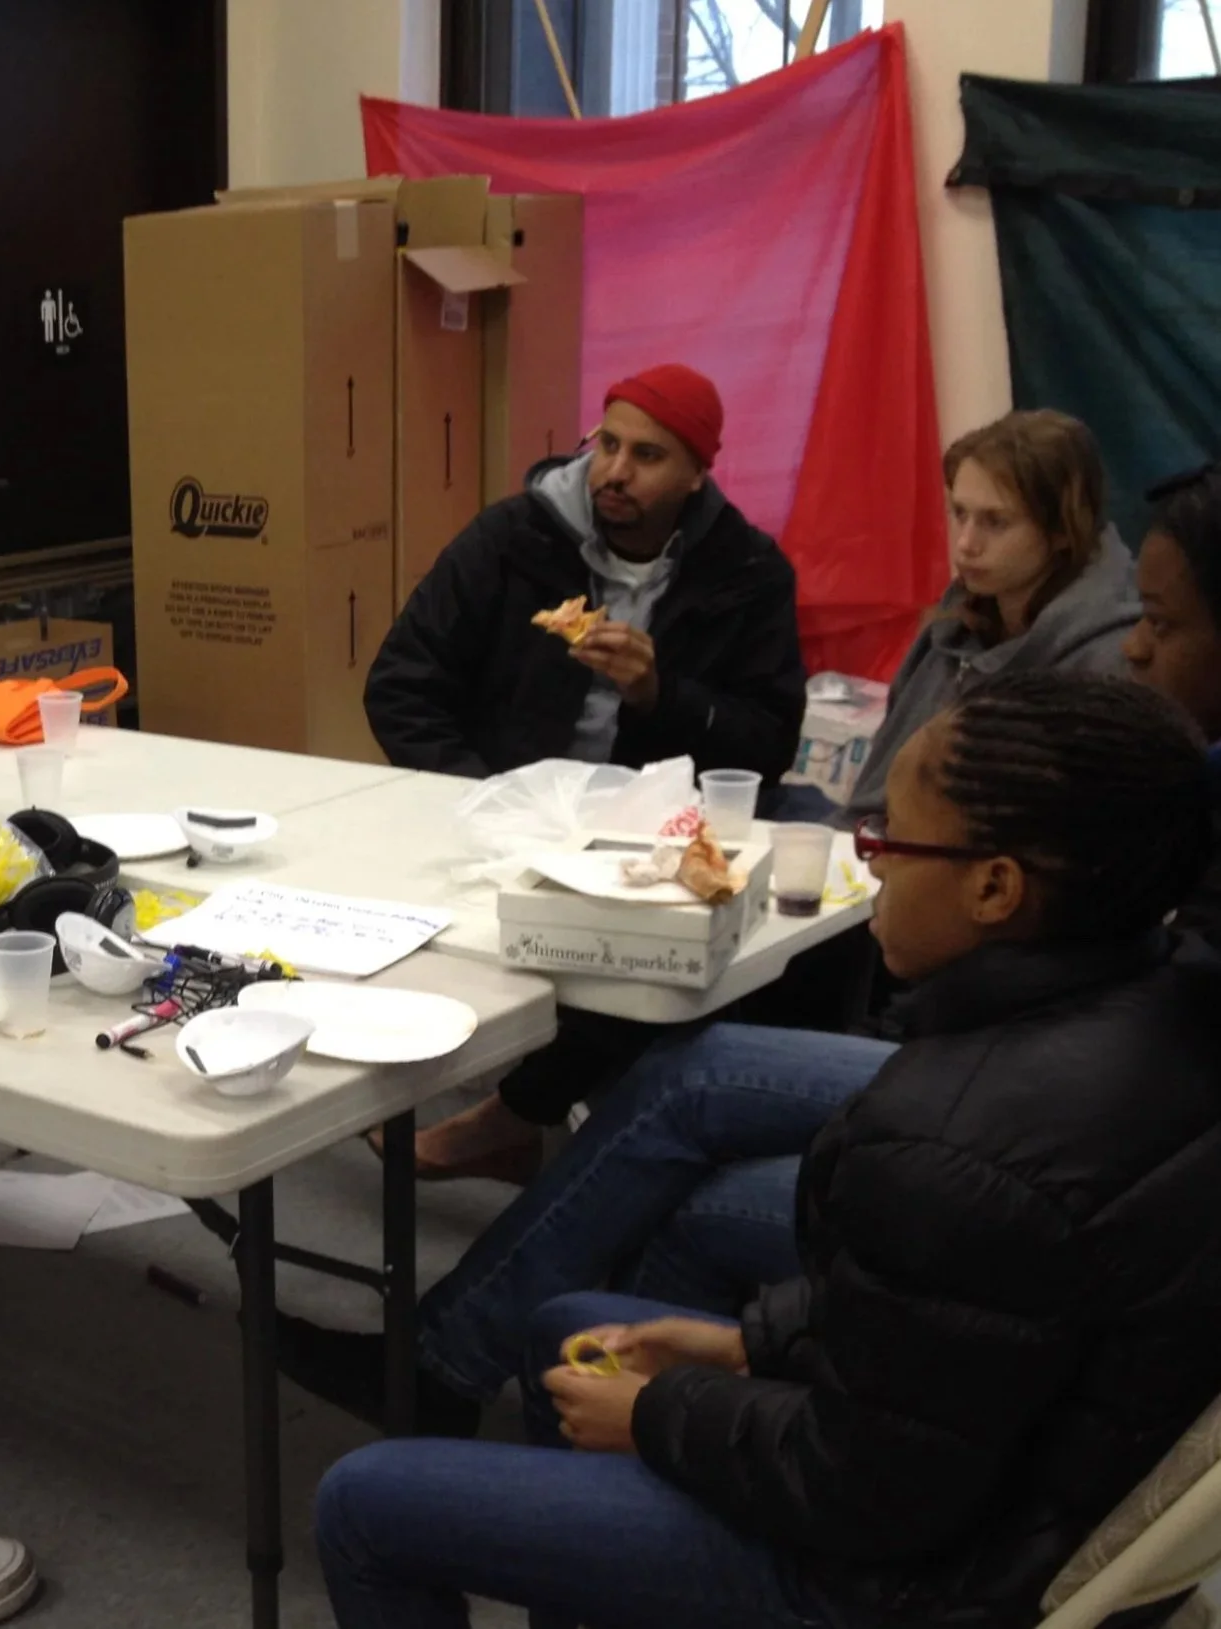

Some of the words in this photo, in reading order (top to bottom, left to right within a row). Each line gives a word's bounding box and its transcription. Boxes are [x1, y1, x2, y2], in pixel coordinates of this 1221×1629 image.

[170, 483, 267, 539] Quickie
[525, 942, 598, 965] shimmer
[601, 947, 615, 965] &
[620, 953, 684, 973] sparkle
